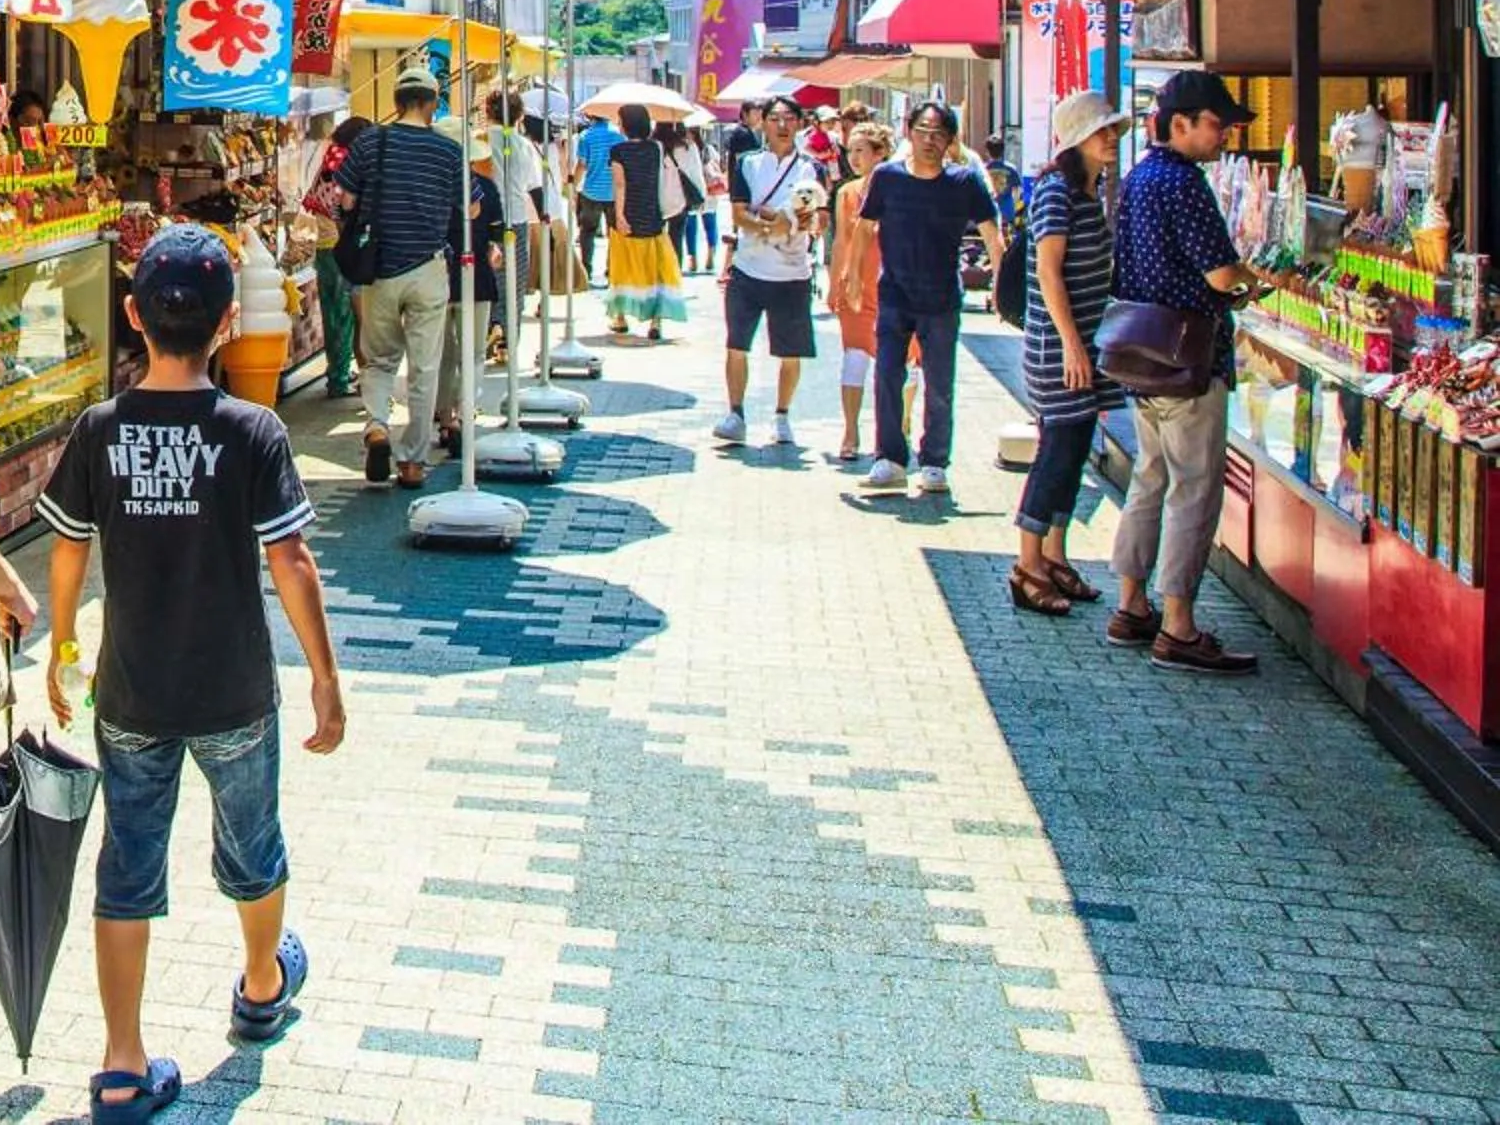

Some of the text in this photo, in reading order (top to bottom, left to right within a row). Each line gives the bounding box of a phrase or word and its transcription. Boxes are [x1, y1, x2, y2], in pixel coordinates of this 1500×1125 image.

[60, 127, 95, 144] 200
[119, 424, 203, 446] EXTRA
[107, 444, 224, 477] HEAVY
[131, 477, 194, 498] DUTY
